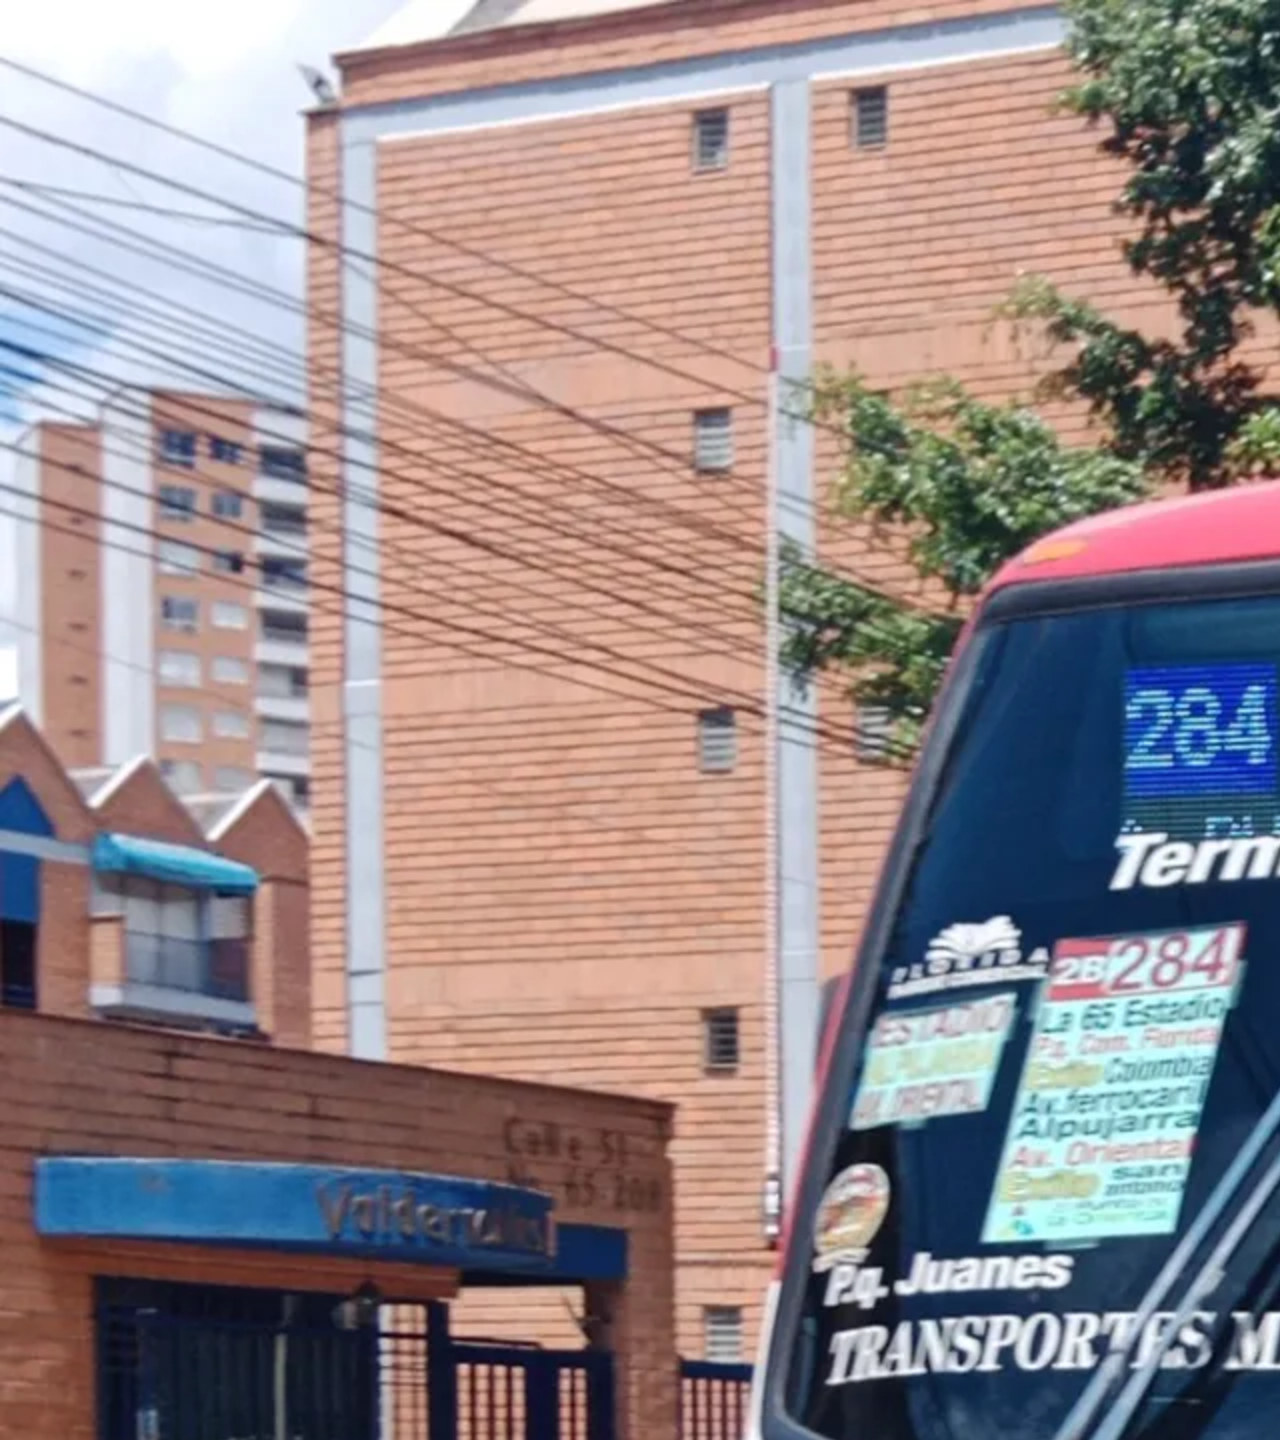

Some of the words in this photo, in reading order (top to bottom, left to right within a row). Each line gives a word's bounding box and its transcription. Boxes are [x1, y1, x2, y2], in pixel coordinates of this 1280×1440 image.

[1124, 685, 1271, 769] 284
[1109, 926, 1231, 991] 284
[1079, 1004, 1116, 1029] 65
[895, 1250, 1074, 1294] Juanes
[827, 1311, 1218, 1384] TRANSPORTES
